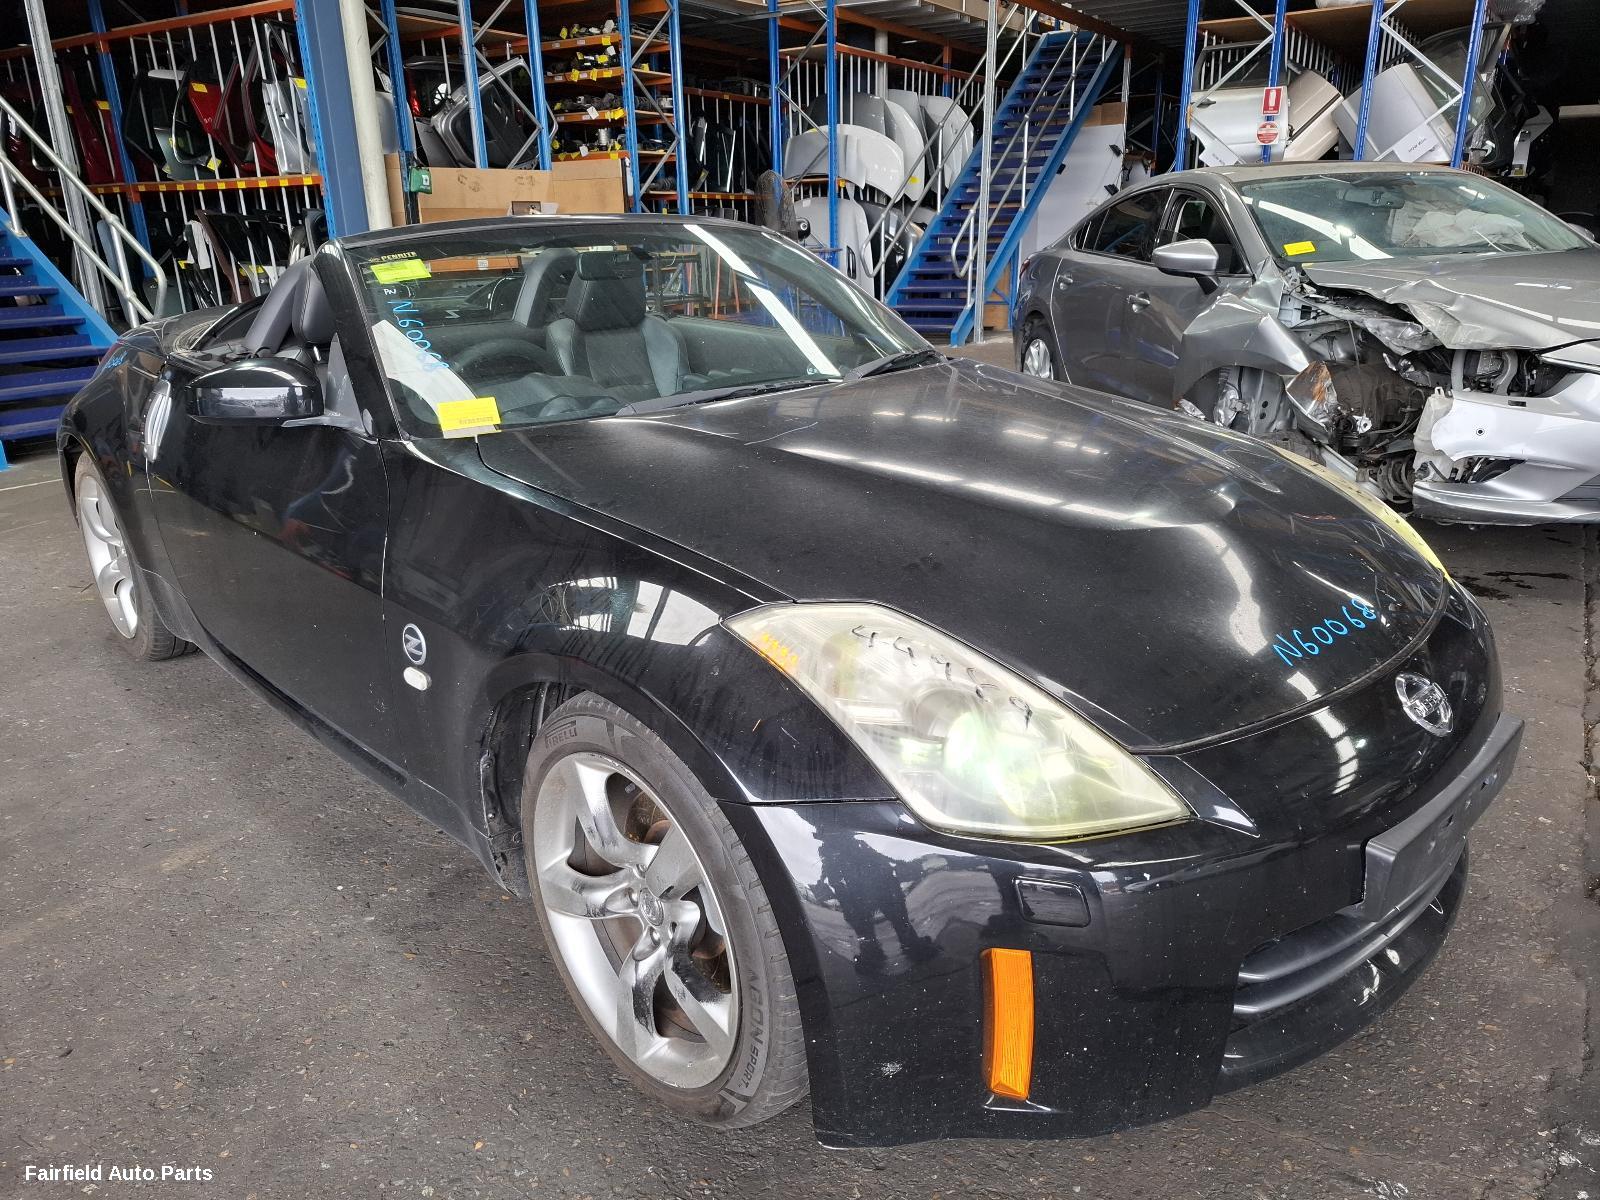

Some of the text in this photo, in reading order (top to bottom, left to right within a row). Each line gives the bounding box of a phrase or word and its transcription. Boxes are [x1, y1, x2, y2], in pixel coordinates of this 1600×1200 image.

[1272, 598, 1377, 667] N60068
[545, 726, 577, 749] PIRELLI
[743, 1045, 760, 1089] SPORT
